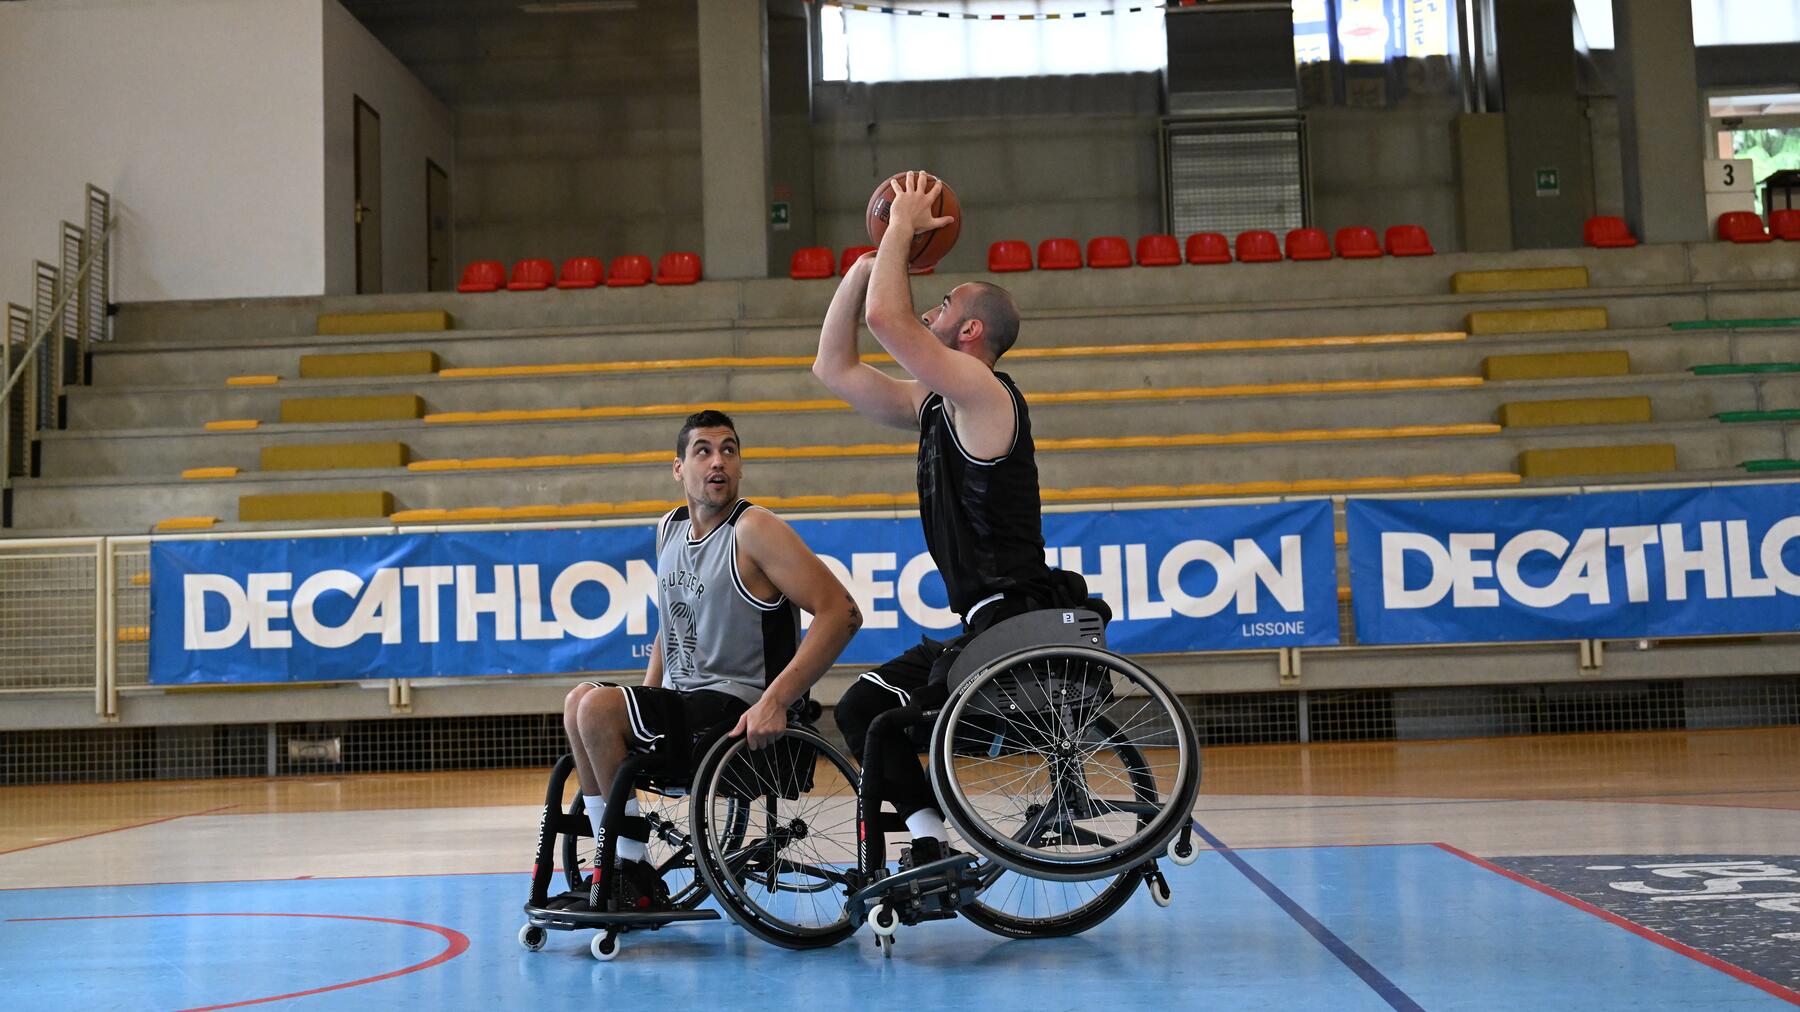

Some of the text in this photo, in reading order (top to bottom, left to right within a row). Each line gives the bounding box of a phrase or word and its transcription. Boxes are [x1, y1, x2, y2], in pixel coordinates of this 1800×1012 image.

[1723, 164, 1734, 186] 3
[1381, 515, 1800, 609] DECATHLO
[1242, 621, 1305, 637] LISSONE
[594, 827, 606, 866] BW500
